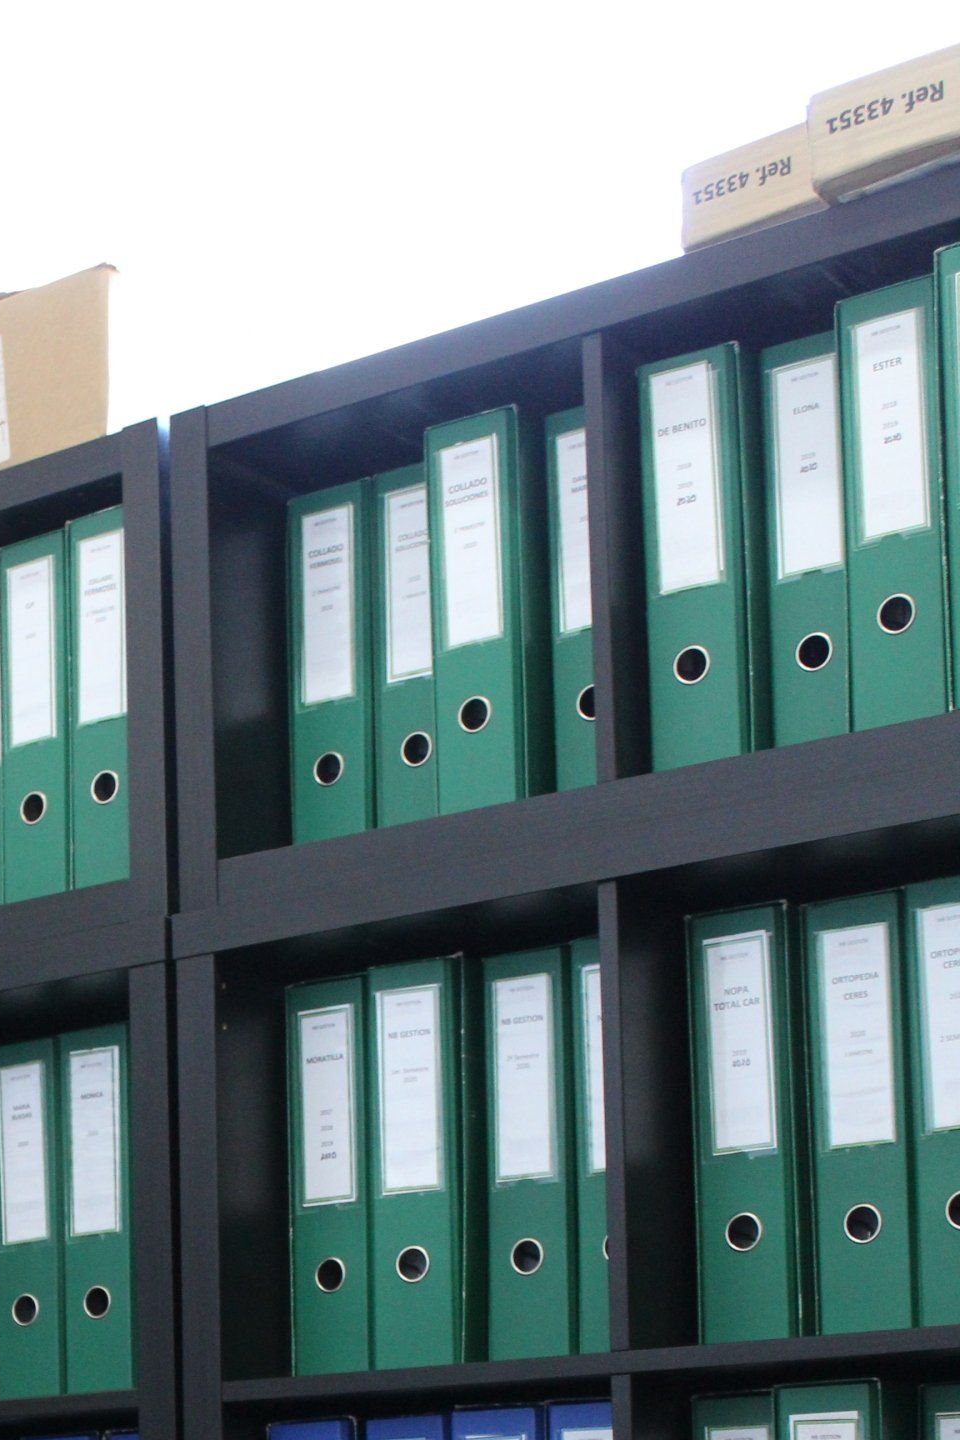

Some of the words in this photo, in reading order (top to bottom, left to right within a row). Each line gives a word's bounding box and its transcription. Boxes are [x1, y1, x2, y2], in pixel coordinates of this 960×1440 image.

[901, 80, 945, 114] Ref.
[826, 97, 895, 135] 43351
[755, 156, 792, 187] Ref.
[692, 170, 750, 206] 43351
[872, 356, 903, 374] ESTER
[657, 425, 670, 438] DE
[671, 418, 707, 435] BENITO
[447, 477, 488, 494] COLLADO
[832, 971, 879, 985] ORTOPEDIA
[724, 986, 749, 995] NOPA
[843, 991, 869, 1001] CERES
[713, 1001, 742, 1012] TOTAL
[743, 997, 760, 1007] CAR
[501, 1018, 512, 1026] NB
[513, 1014, 544, 1024] GESTION
[400, 1028, 431, 1038] GESTION
[306, 1053, 344, 1065] MORATILLA
